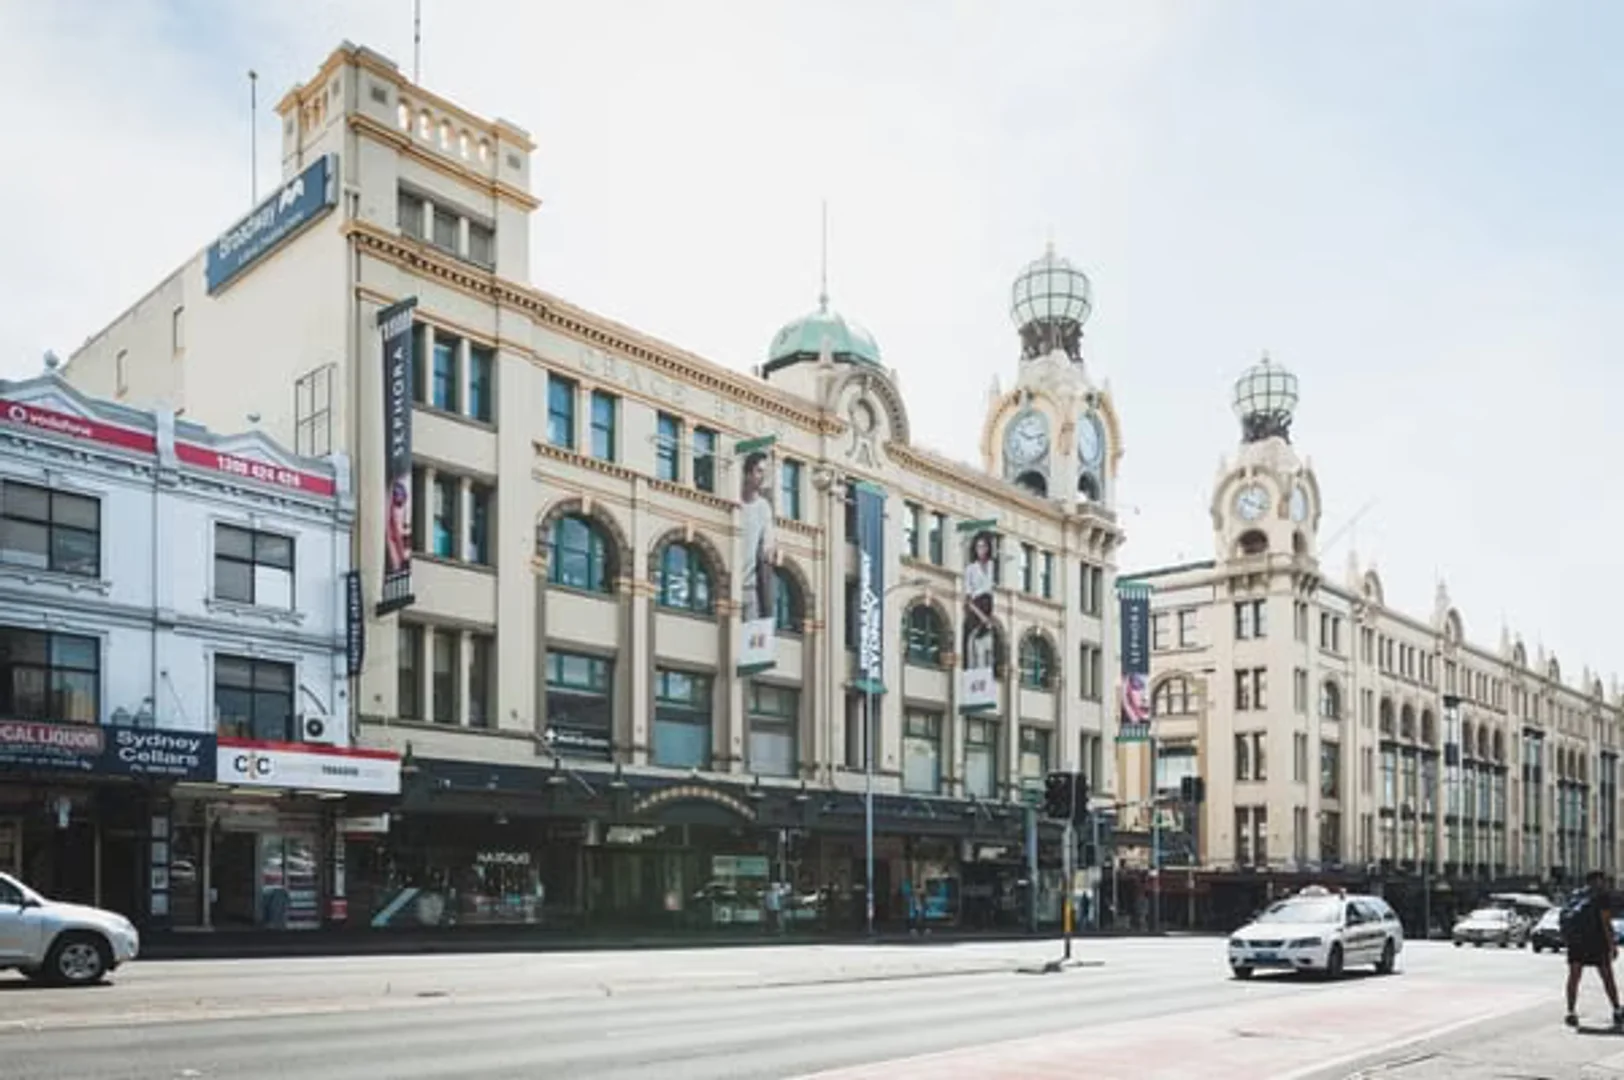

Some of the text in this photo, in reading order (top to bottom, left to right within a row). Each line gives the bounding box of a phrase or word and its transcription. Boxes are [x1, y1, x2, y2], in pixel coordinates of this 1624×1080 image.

[391, 346, 405, 458] SEPHORA
[0, 725, 36, 742] CAL
[116, 730, 200, 753] Sydney
[119, 747, 199, 768] Cellars
